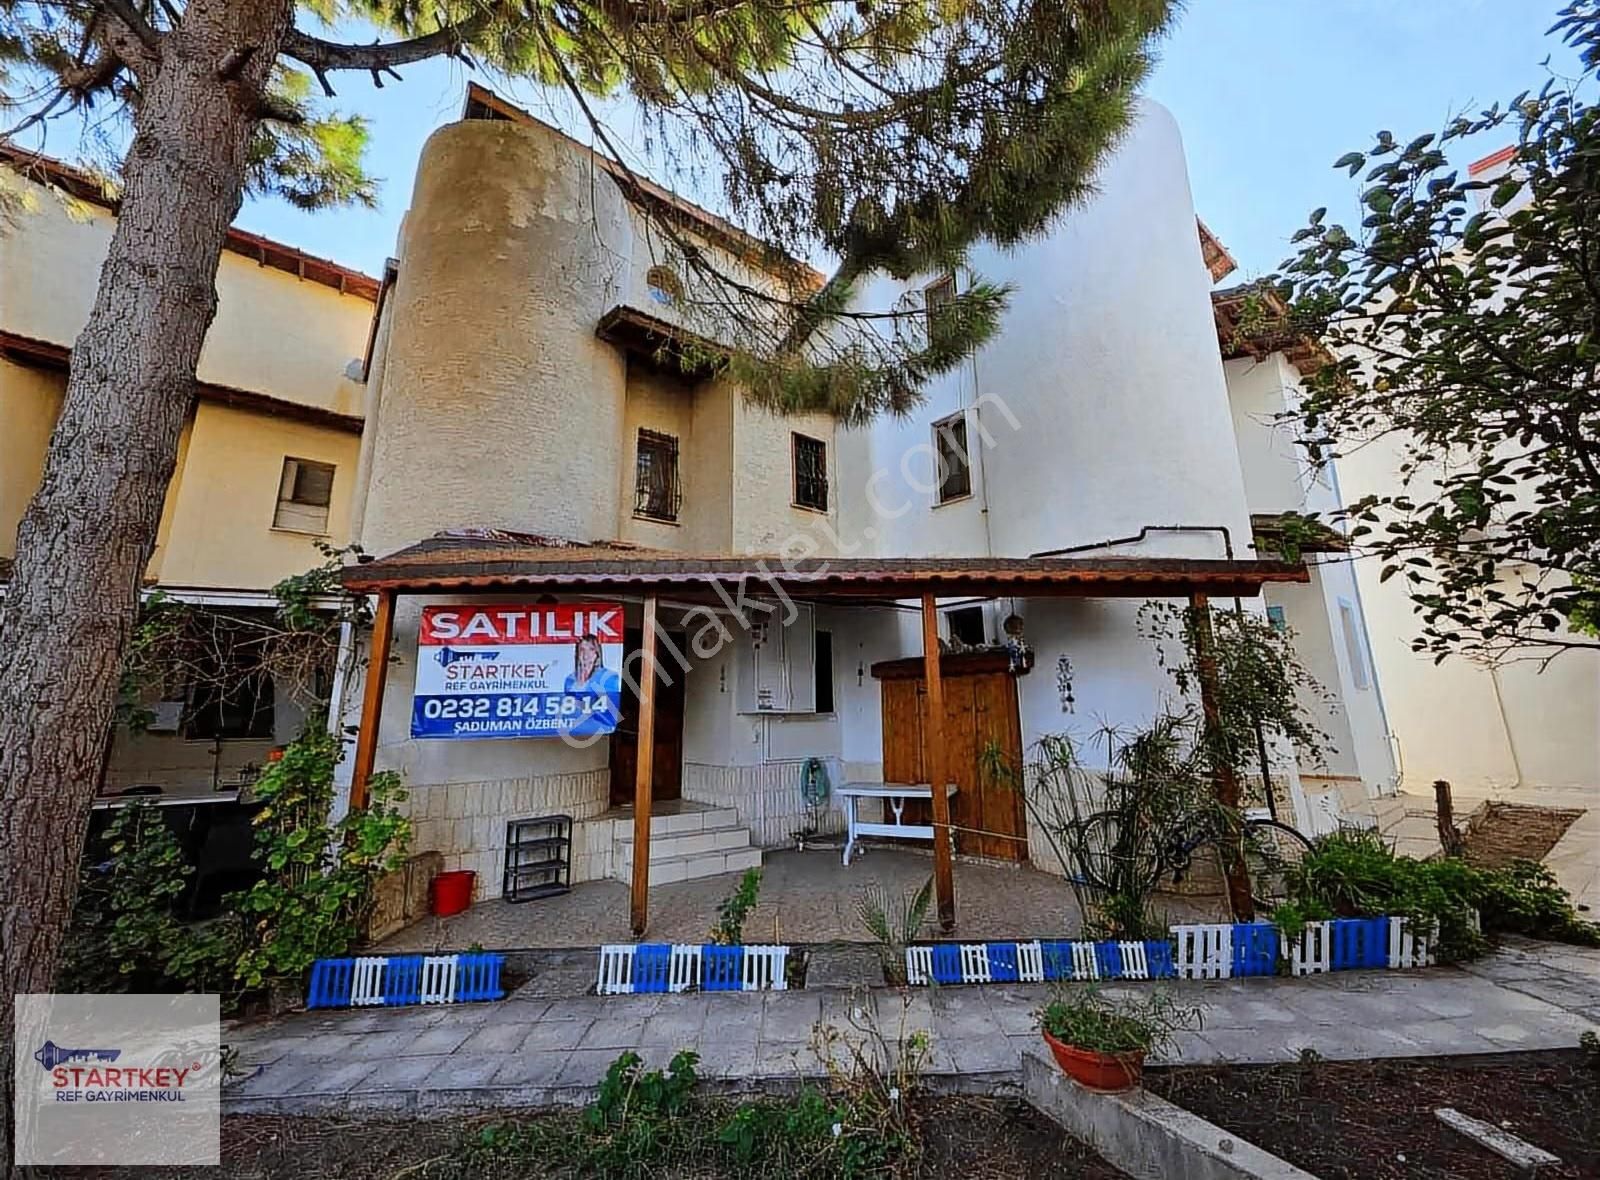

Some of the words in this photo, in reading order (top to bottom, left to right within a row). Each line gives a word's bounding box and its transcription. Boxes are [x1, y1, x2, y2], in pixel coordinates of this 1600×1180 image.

[430, 610, 619, 639] SATILIK
[446, 663, 549, 680] STARTKEY
[445, 681, 467, 691] REF
[469, 678, 549, 691] GAYRİMENKUL
[424, 698, 490, 719] 0232
[496, 697, 539, 717] 814
[545, 696, 576, 716] 58
[581, 695, 608, 714] 14
[453, 720, 522, 734] ŞADUMAN
[525, 717, 577, 731] ÖZBENT
